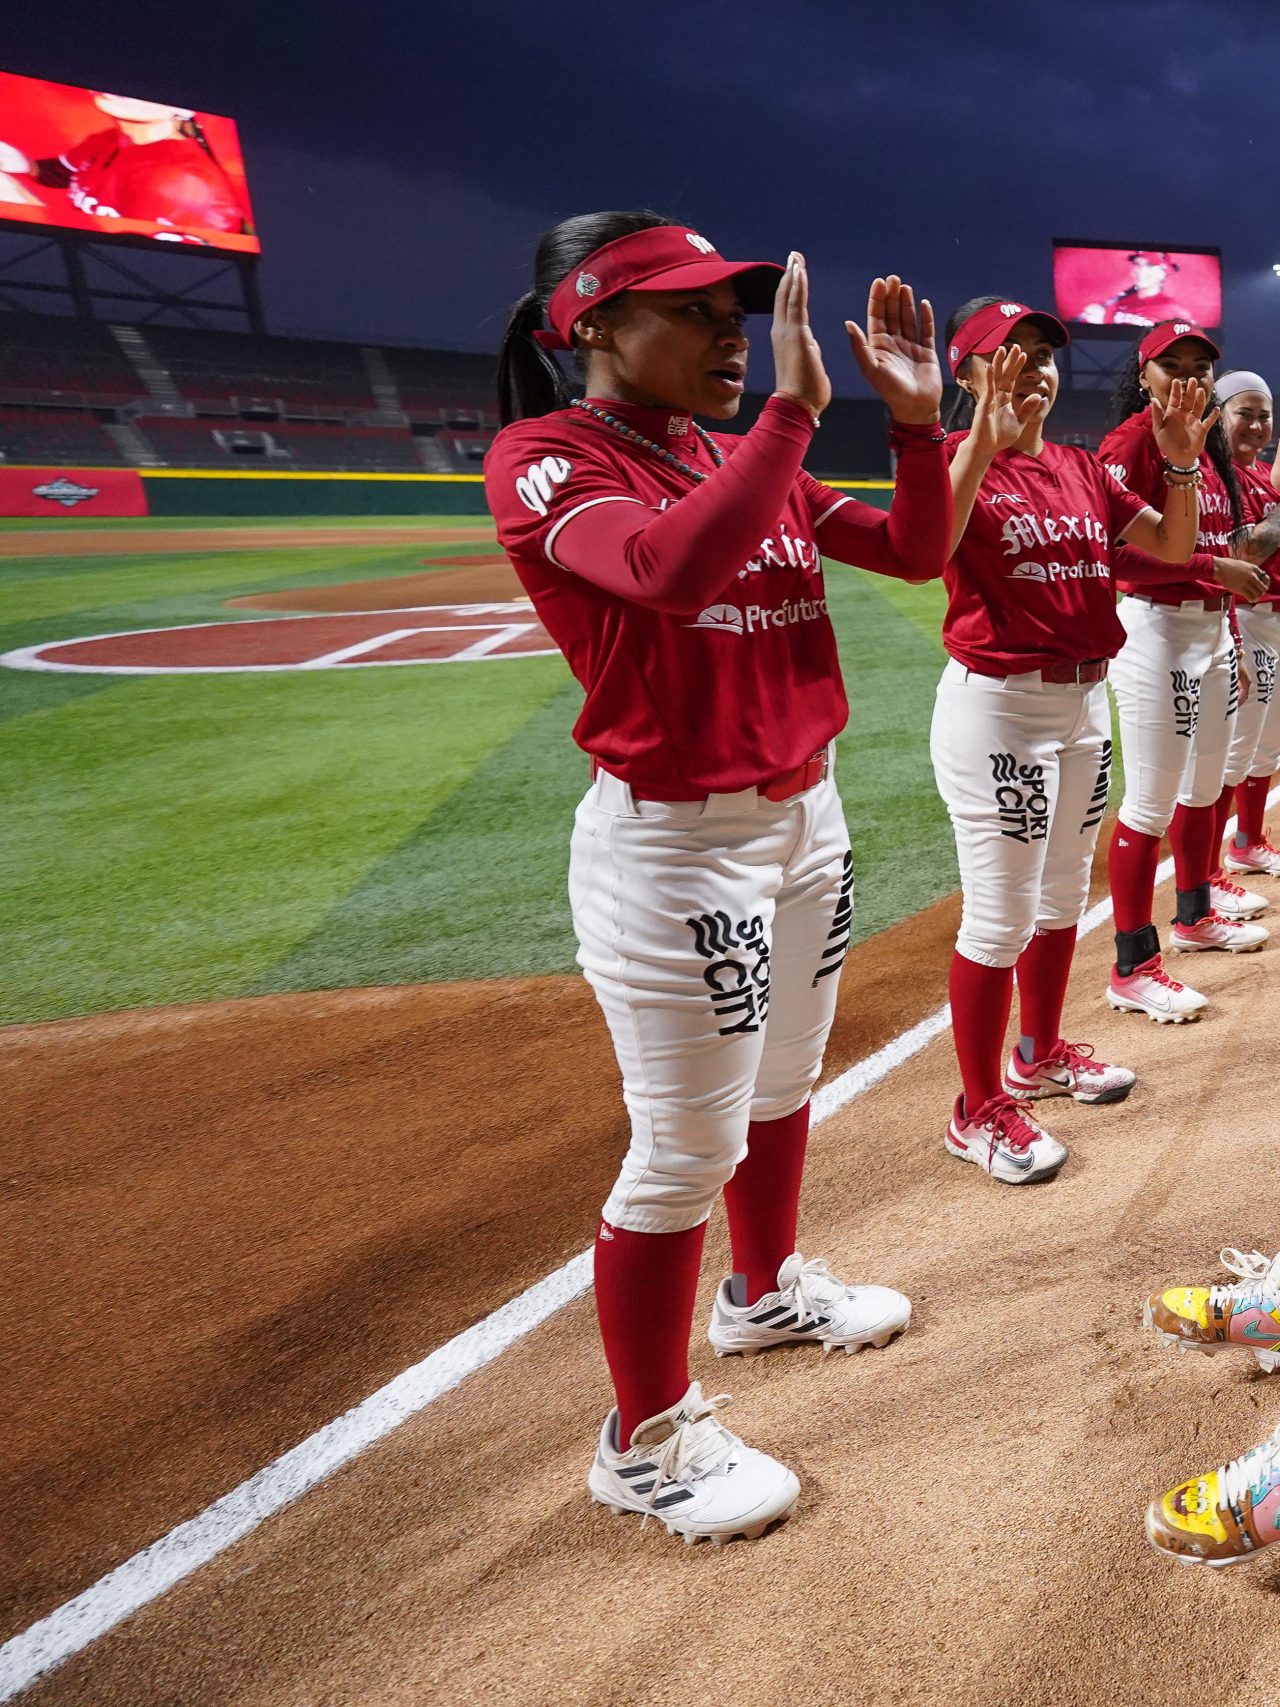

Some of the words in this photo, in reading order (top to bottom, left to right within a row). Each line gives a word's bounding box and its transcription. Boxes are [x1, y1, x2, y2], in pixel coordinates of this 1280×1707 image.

[1000, 509, 1107, 556] Méxic
[1257, 669, 1268, 704] CITY
[1173, 695, 1192, 738] CITY
[995, 786, 1029, 844] CITY
[1019, 764, 1048, 840] SPORT
[703, 959, 759, 1036] CITY
